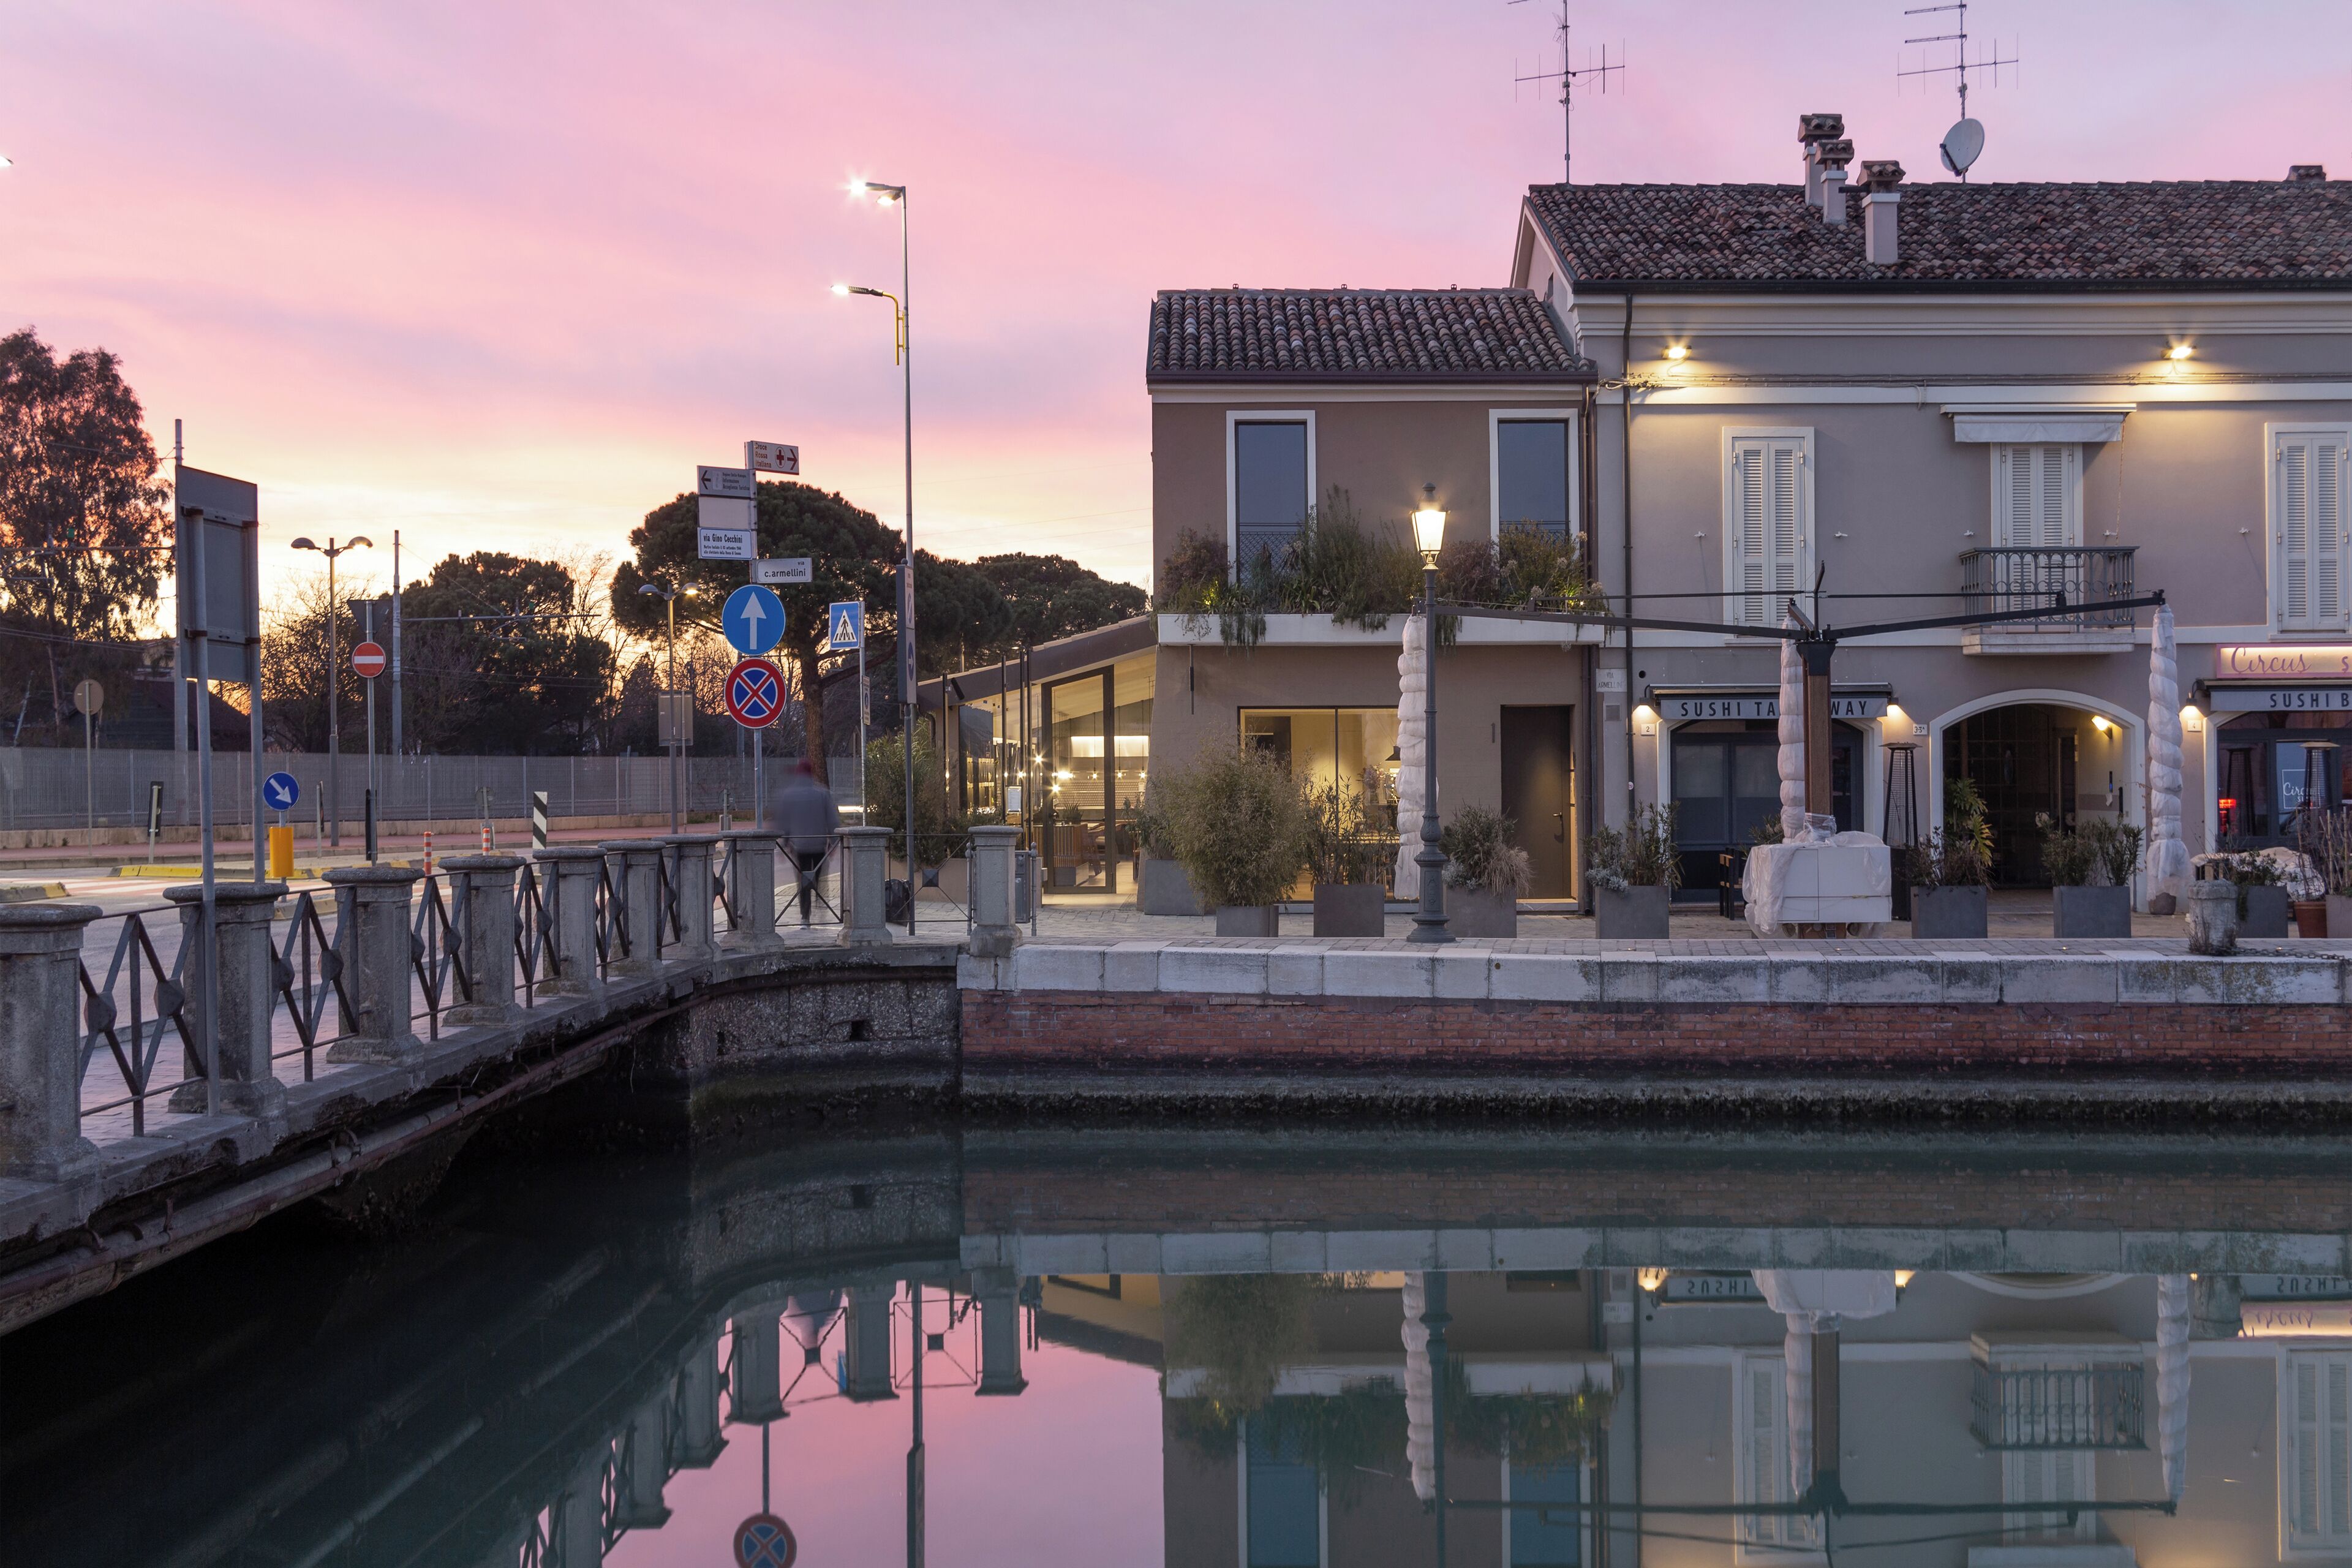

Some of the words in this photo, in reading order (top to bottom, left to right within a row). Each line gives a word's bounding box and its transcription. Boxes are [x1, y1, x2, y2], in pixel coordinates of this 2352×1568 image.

[712, 533, 722, 542] Gino
[724, 534, 742, 543] Cecchini
[764, 568, 806, 578] c.armellini
[2231, 647, 2312, 674] Circus
[2270, 693, 2330, 708] SUSHI
[1681, 702, 1741, 717] SUSHI
[2284, 782, 2305, 796] Circ
